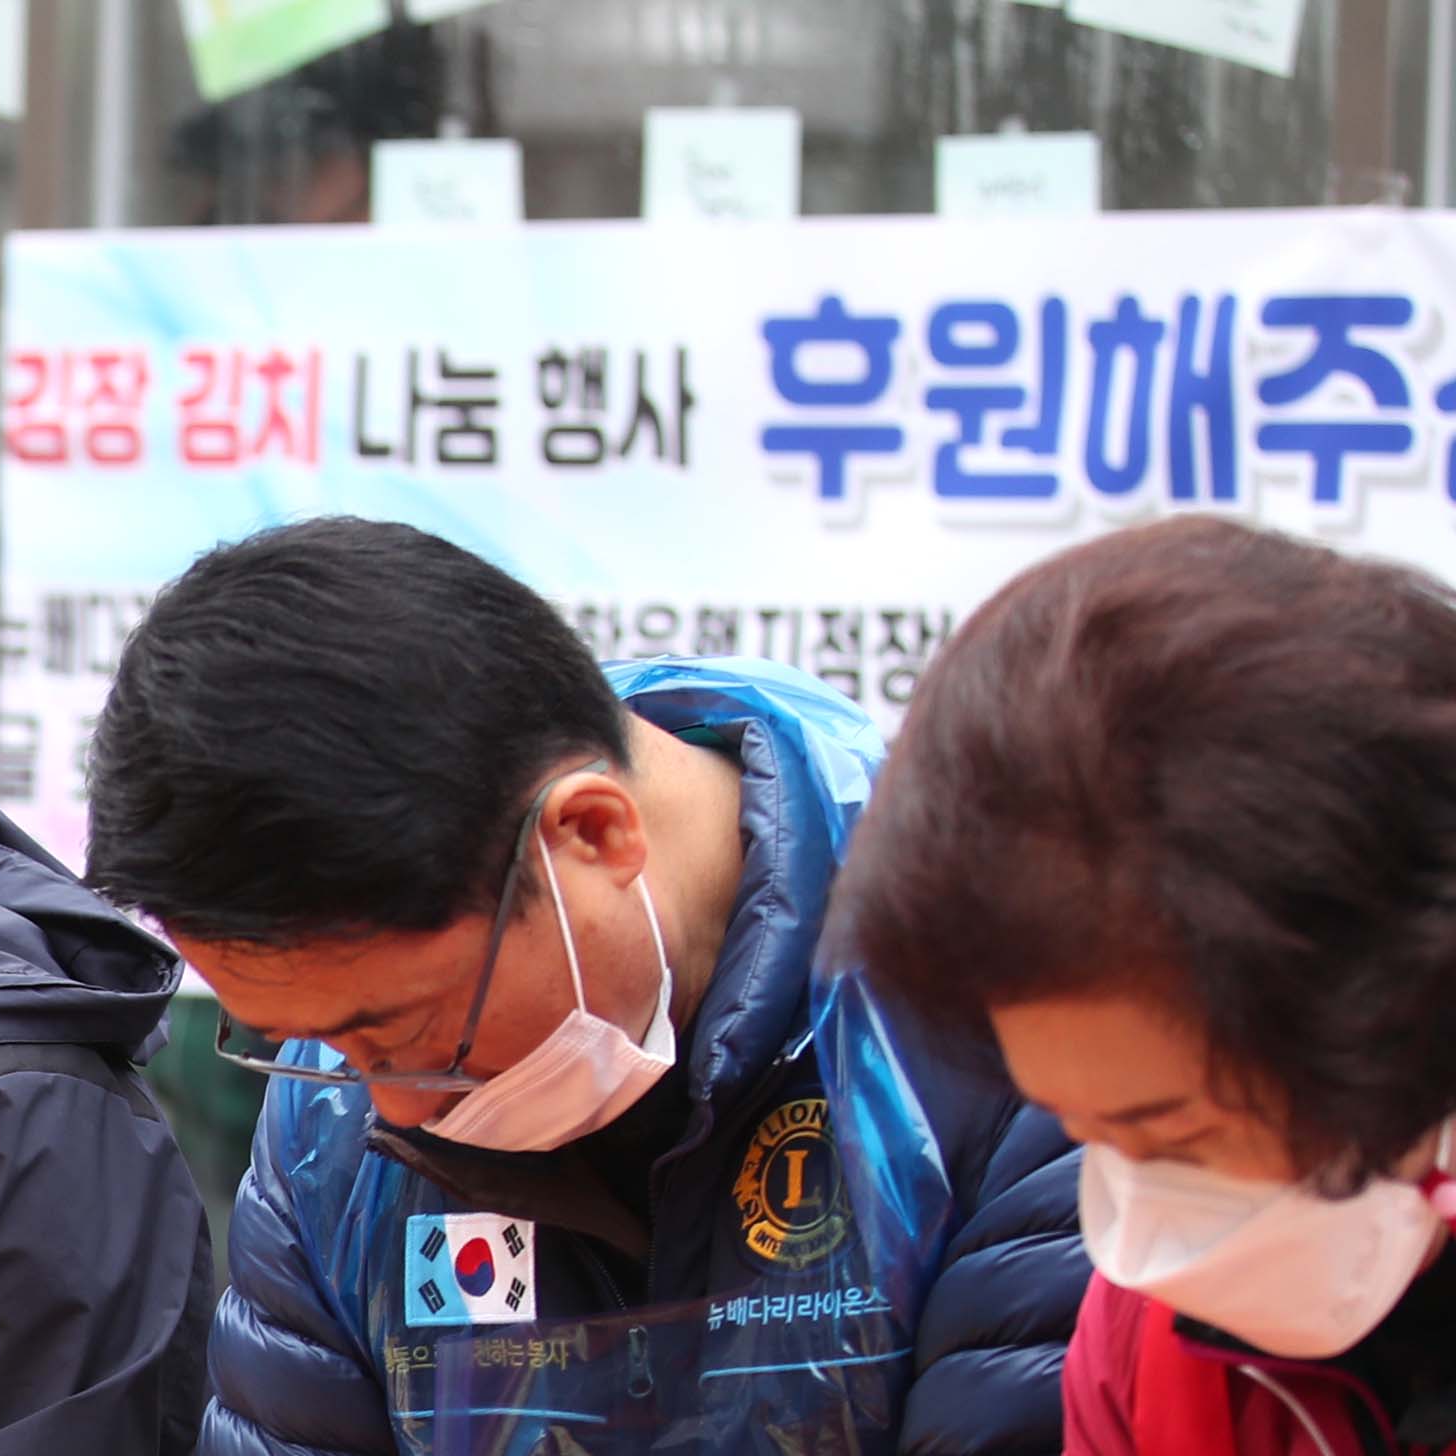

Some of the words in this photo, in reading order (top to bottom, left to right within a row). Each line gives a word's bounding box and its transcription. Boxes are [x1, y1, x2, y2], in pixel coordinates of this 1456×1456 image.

[3, 348, 149, 465] 김장
[176, 344, 324, 466] 김치
[354, 347, 500, 466] 나눔
[538, 344, 696, 467] 행사
[760, 294, 1456, 503] 후원해주
